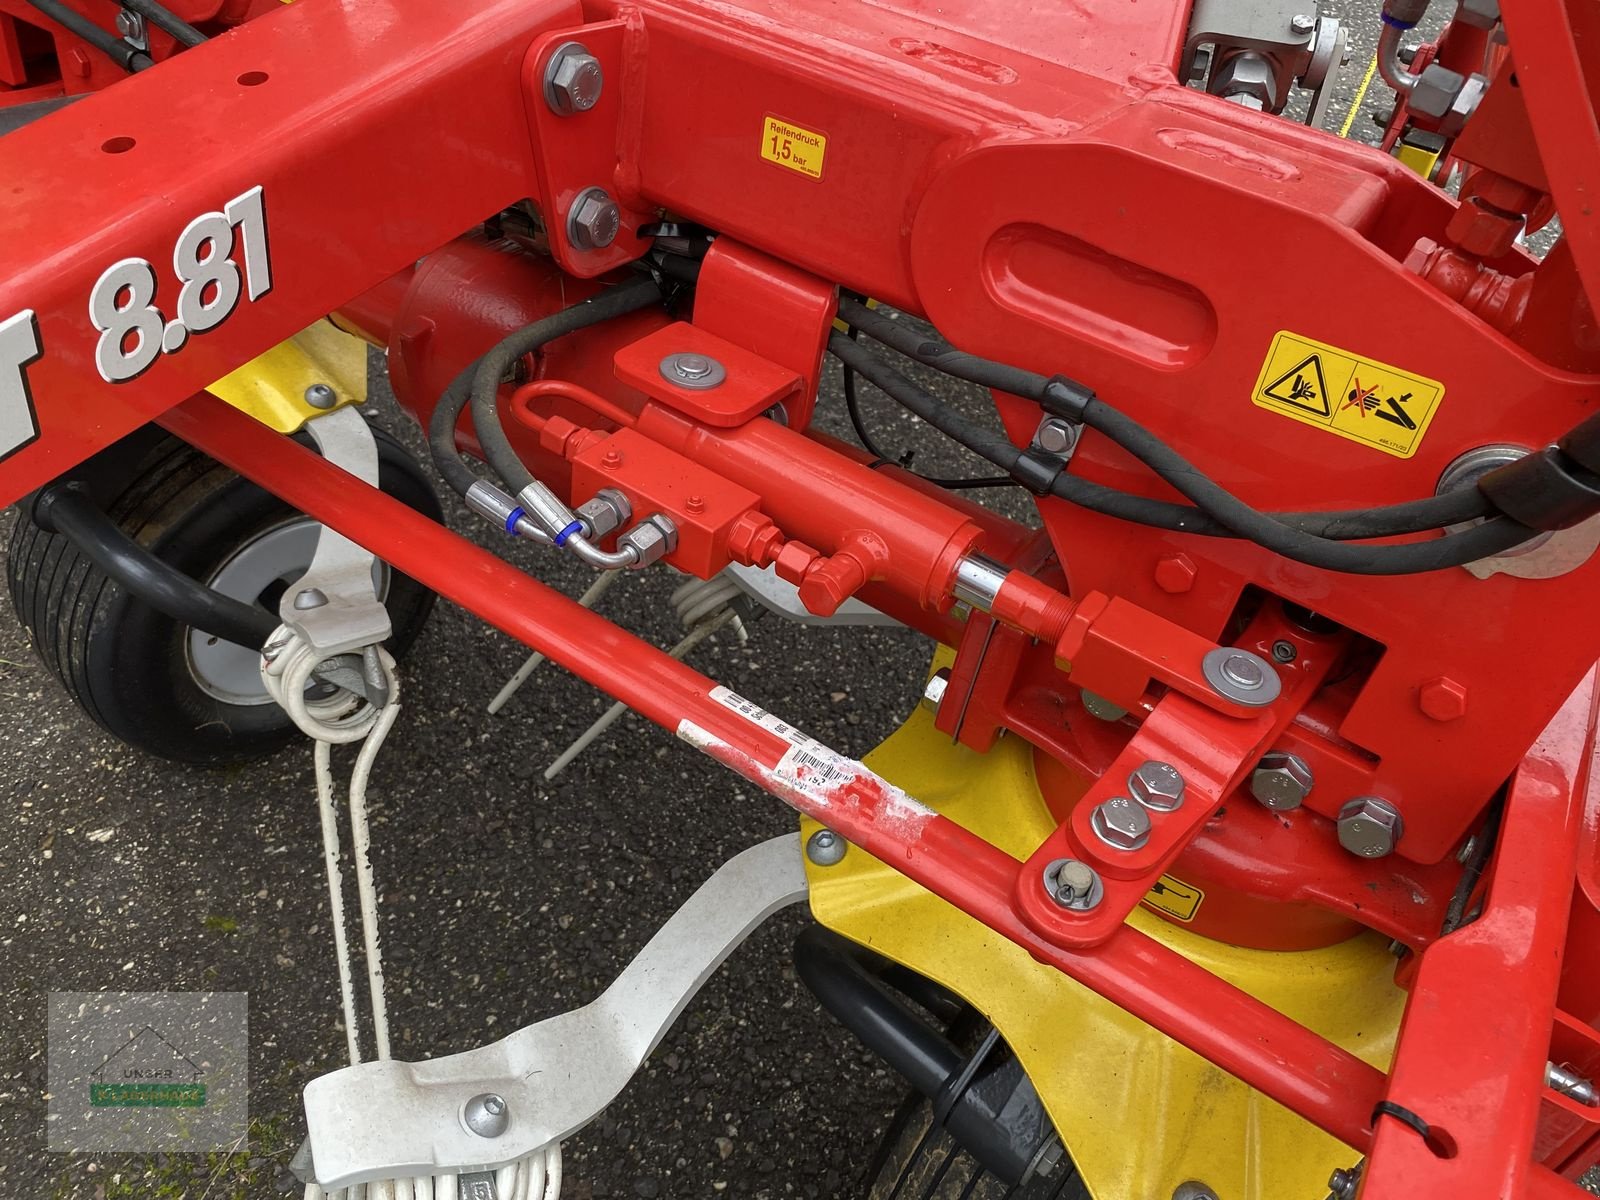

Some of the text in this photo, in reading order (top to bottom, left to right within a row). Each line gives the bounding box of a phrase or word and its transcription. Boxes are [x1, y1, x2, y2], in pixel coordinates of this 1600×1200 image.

[770, 122, 820, 147] Reifendruck
[771, 135, 807, 165] 1,5 bar
[89, 185, 273, 383] 8.81
